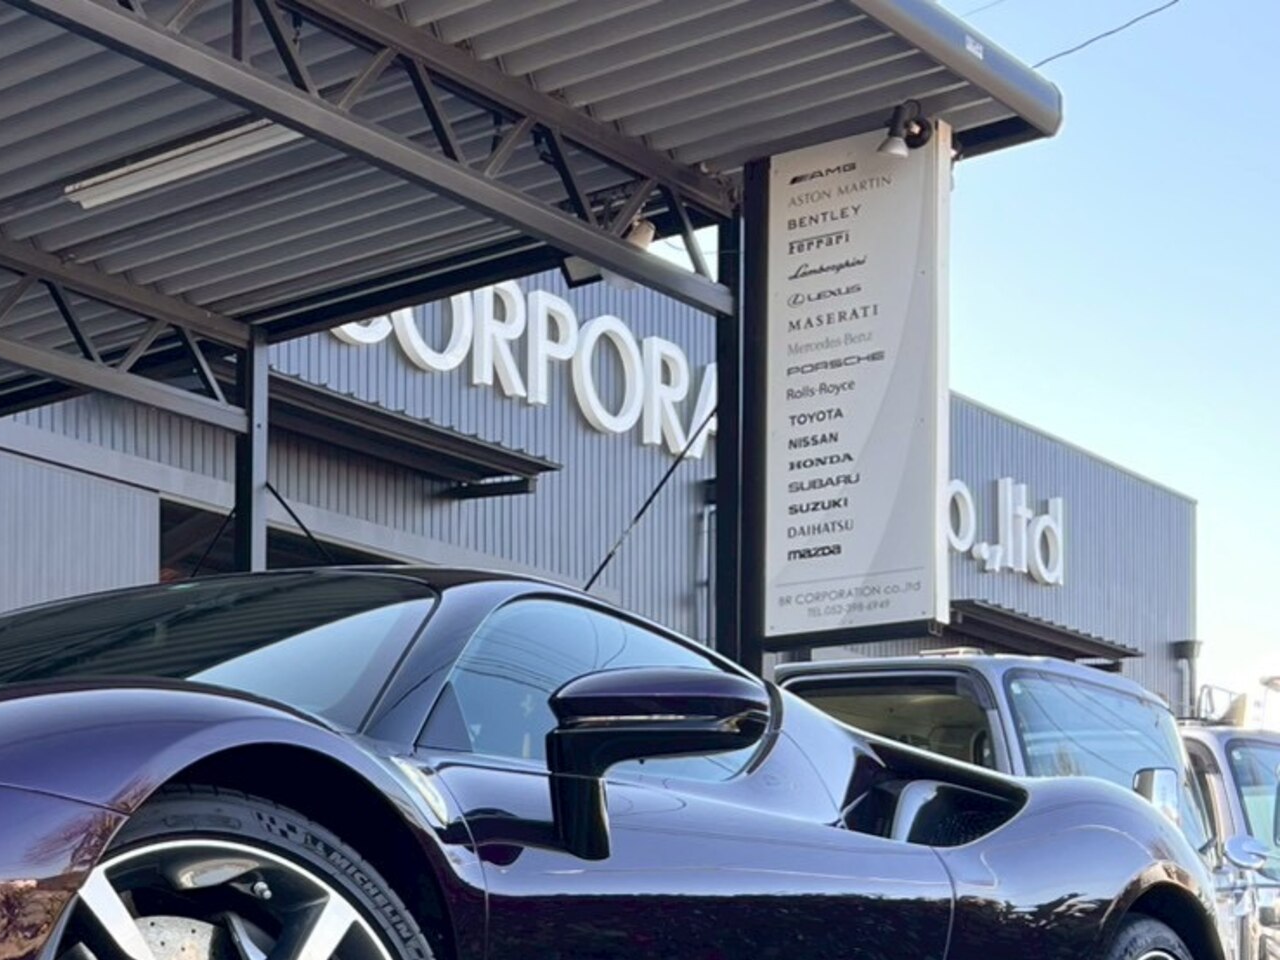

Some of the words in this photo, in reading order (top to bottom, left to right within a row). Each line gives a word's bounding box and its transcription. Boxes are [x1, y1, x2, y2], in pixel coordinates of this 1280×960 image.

[808, 162, 857, 180] AMG
[787, 189, 832, 208] ASTON
[837, 175, 893, 197] MARTIN
[787, 204, 862, 231] BENTLEY
[788, 230, 850, 255] Ferrari
[787, 255, 867, 281] Lamborghini
[807, 283, 862, 302] LEXUS
[787, 304, 880, 333] MASERATI
[329, 279, 718, 459] ORPORA
[786, 350, 885, 376] PORSCHE
[789, 407, 844, 427] TOYOTA
[788, 432, 839, 450] NISSAN
[788, 453, 853, 471] HONDA
[788, 472, 861, 493] SUBARU
[788, 497, 849, 516] SUZUKI
[787, 518, 854, 539] DAIHATSU
[787, 544, 842, 561] mazda
[779, 596, 792, 607] BR
[794, 584, 882, 606] CORPORATION
[327, 850, 416, 941] MICHELIN
